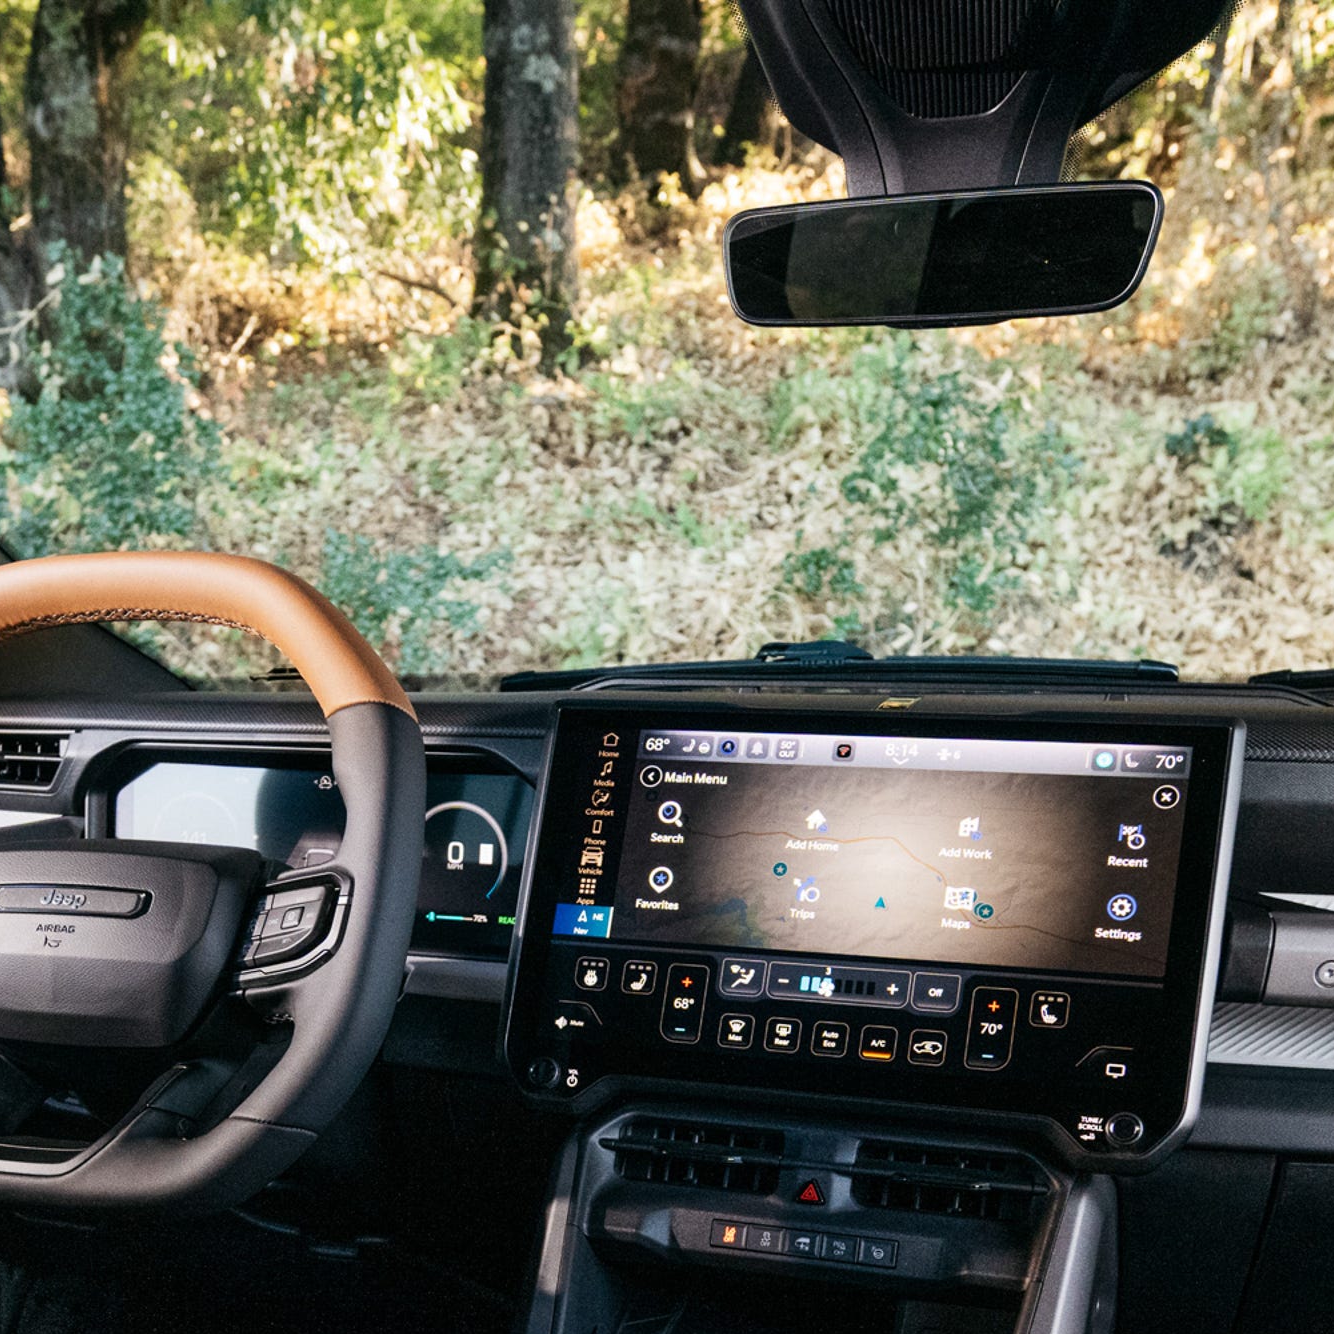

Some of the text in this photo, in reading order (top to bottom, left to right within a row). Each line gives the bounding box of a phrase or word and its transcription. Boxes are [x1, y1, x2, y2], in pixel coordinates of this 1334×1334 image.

[645, 738, 670, 751] 68°
[885, 743, 918, 757] 8:14
[598, 750, 619, 758] Home
[1155, 754, 1184, 769] 70°
[593, 779, 615, 788] Media
[664, 771, 728, 785] Main Menu
[585, 807, 614, 817] Comfort
[584, 836, 606, 846] Phone
[650, 832, 684, 844] Search
[785, 839, 839, 852] Add Home
[447, 841, 464, 864] 0
[938, 847, 993, 860] Add Work
[1107, 855, 1149, 868] Recent
[578, 866, 603, 876] Vehicle
[40, 889, 87, 909] Jeep
[576, 897, 595, 906] Apps
[635, 898, 679, 911] Favorites
[592, 912, 604, 921] NE
[789, 908, 815, 920] Trips
[36, 924, 76, 933] AIRBAG
[941, 918, 970, 929] Maps
[573, 926, 588, 935] Nav
[1095, 927, 1142, 942] Settings
[928, 987, 944, 998] Off
[673, 997, 695, 1010] 68°
[822, 1030, 839, 1039] Auto
[979, 1022, 1003, 1035] 70°
[823, 1039, 836, 1048] Eco
[870, 1039, 886, 1048] A/C
